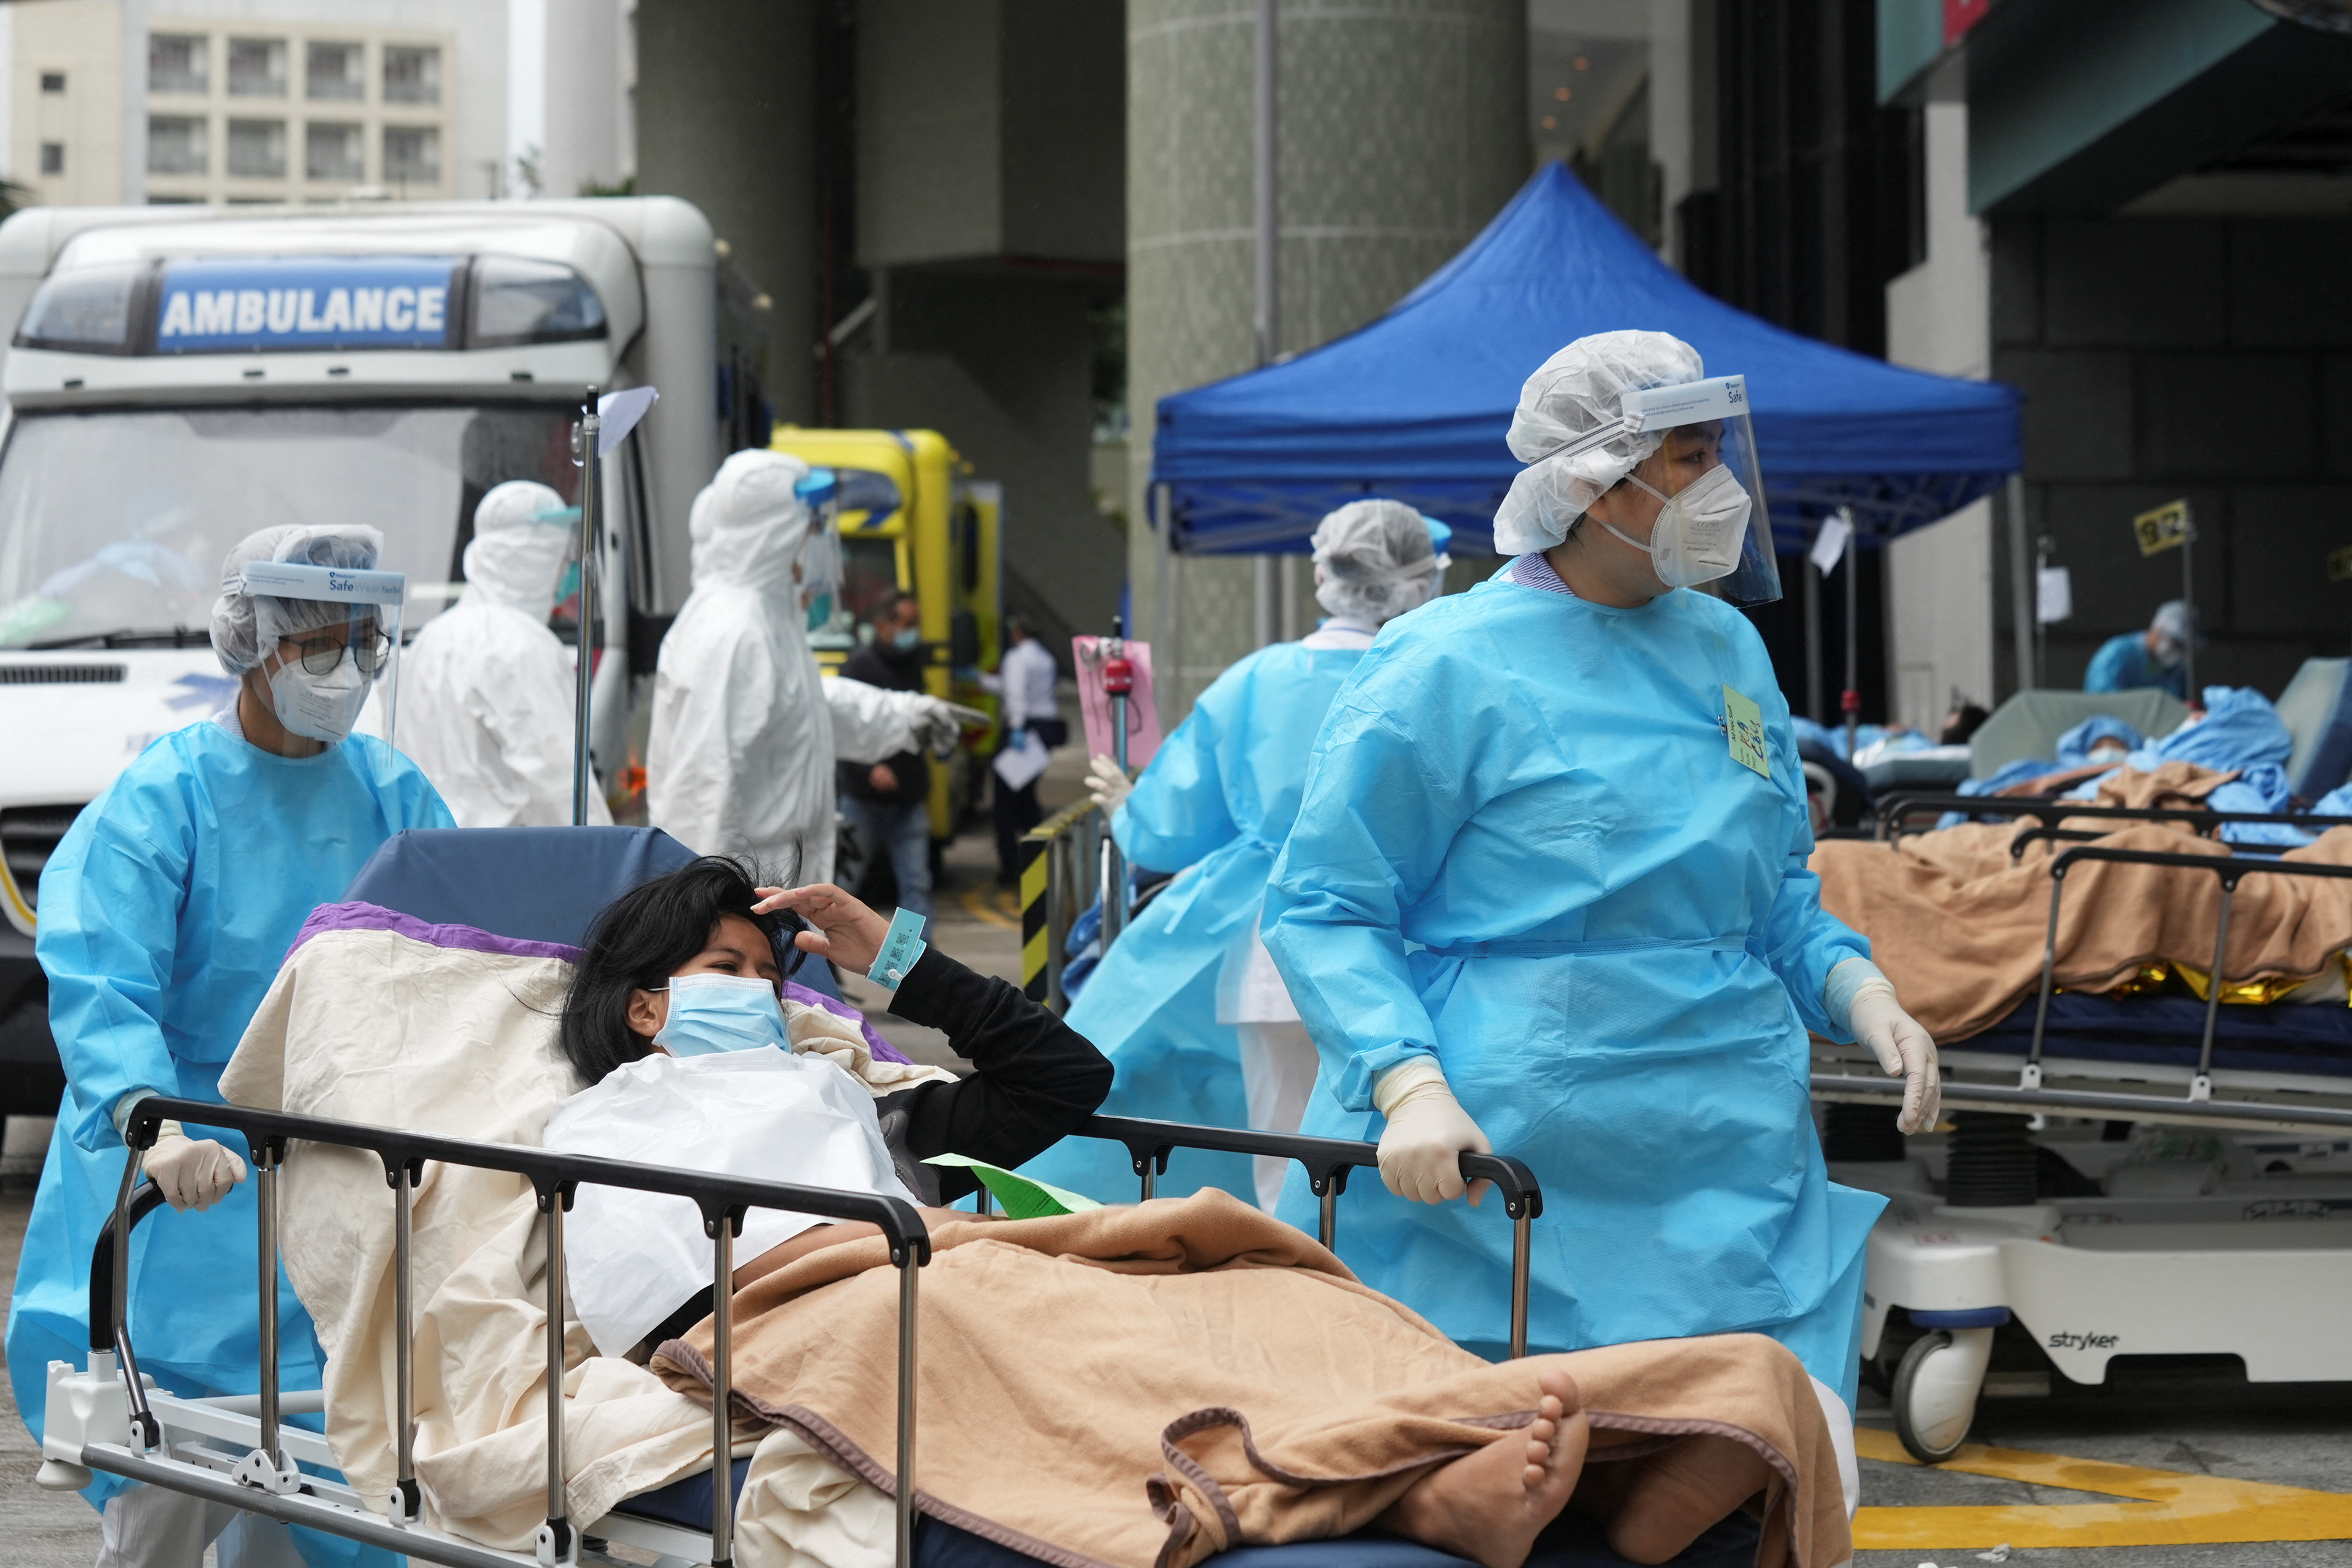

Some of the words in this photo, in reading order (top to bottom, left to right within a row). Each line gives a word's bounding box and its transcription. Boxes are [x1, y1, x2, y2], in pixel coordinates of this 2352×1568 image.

[161, 287, 446, 336] AMBULANCE
[1728, 390, 1743, 403] Safe
[2048, 1331, 2119, 1351] stryker
